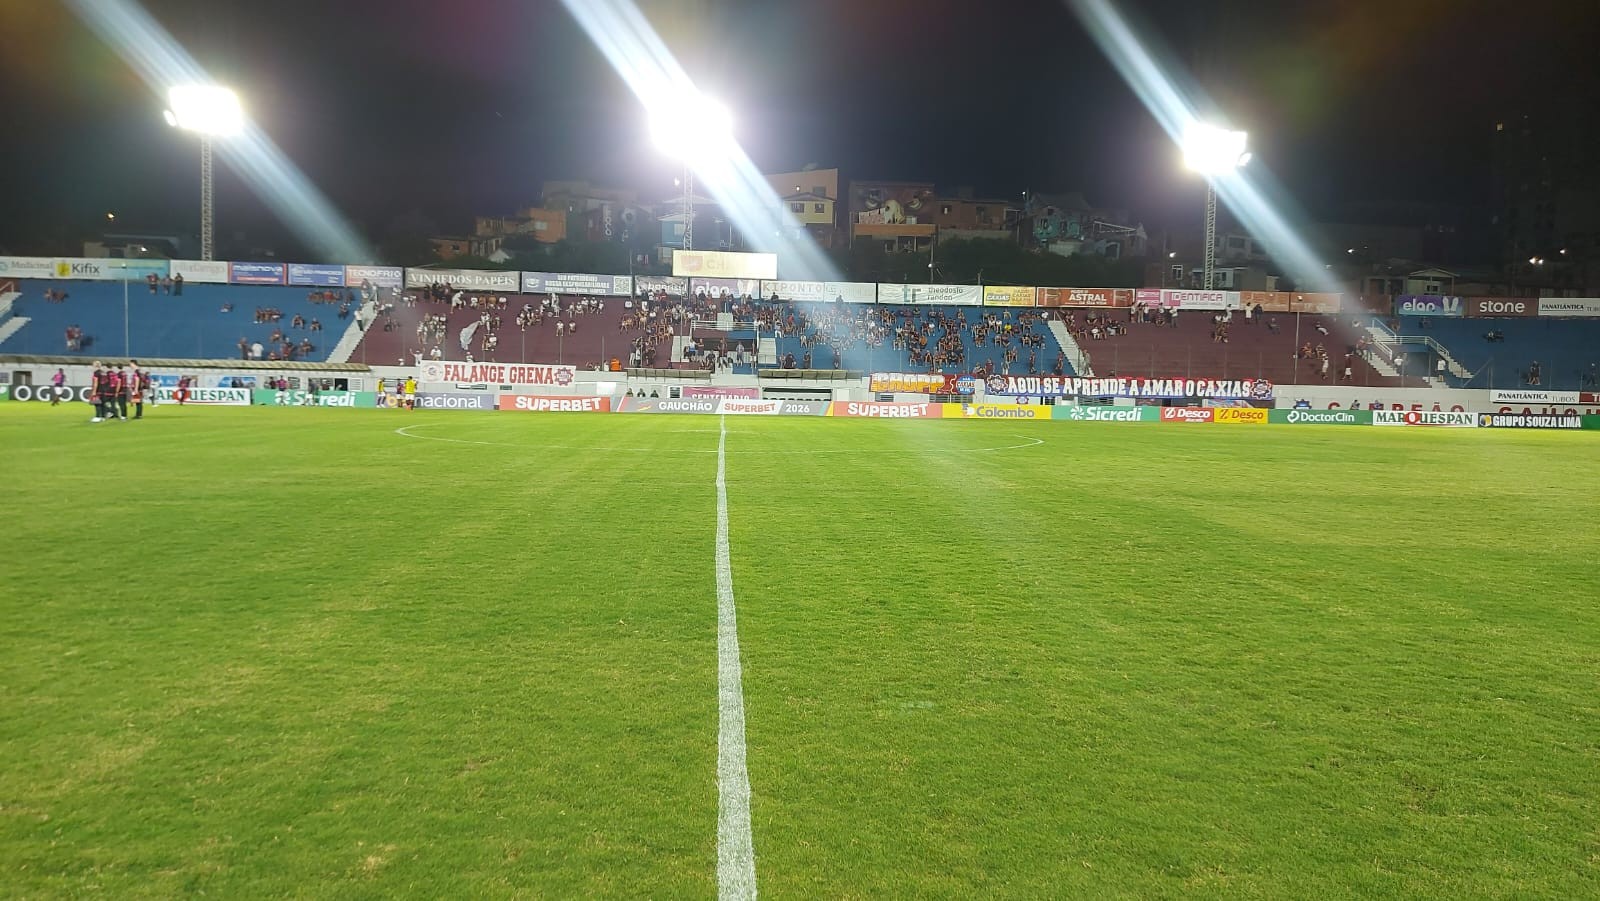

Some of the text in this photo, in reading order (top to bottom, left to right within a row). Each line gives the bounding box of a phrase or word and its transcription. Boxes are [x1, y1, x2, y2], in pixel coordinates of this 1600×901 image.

[71, 263, 100, 274] Kifix
[410, 273, 473, 284] VINHEDOS
[1069, 293, 1108, 301] ASTRAL
[1403, 299, 1436, 312] elan
[1479, 300, 1526, 313] stone
[443, 364, 505, 384] FALANGE
[1008, 377, 1041, 394] AQUI
[1044, 377, 1060, 394] SE
[1062, 377, 1127, 396] APRENDE
[1129, 378, 1140, 396] A
[1141, 378, 1183, 396] AMAR
[1185, 379, 1195, 397] O
[1196, 380, 1250, 397] CAXIAS
[157, 389, 246, 401] ARQUESPAN
[1498, 392, 1548, 400] PANATLÂNTICA
[515, 396, 601, 411] SUPERBET
[658, 400, 810, 413] GAUCHÃO SUPERBET 2026
[847, 402, 929, 417] SUPERBET
[976, 405, 1035, 418] Colombo
[1086, 407, 1142, 421] Sicredi
[1177, 408, 1210, 418] Desco
[1231, 409, 1264, 420] Desco
[1300, 412, 1355, 422] DoctorClin
[1376, 412, 1474, 424] MARQUESPAN
[1492, 415, 1582, 428] GRUPO SOUZA LIMA
